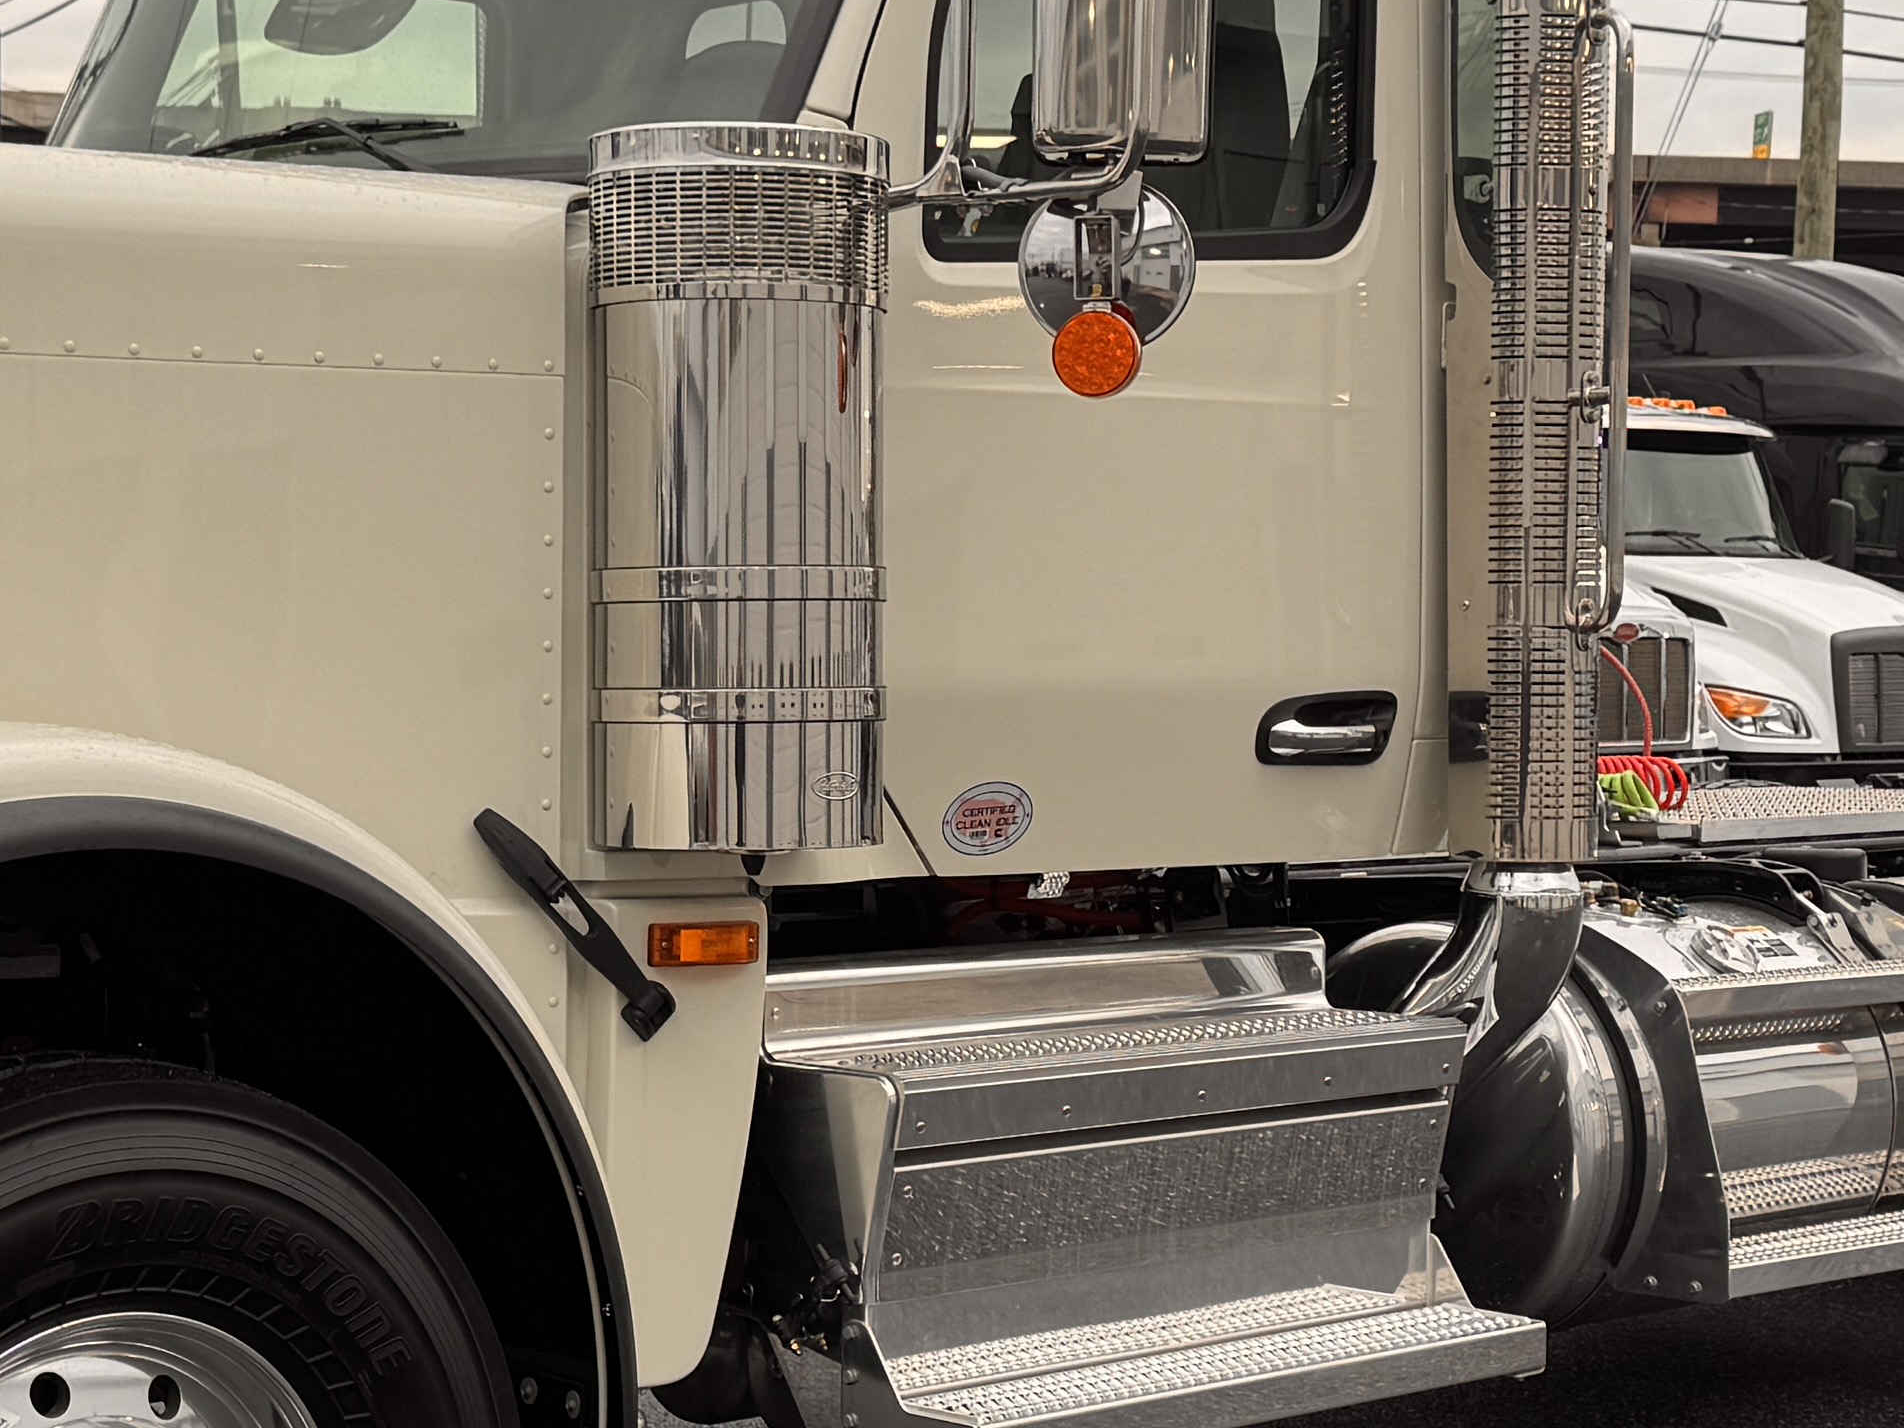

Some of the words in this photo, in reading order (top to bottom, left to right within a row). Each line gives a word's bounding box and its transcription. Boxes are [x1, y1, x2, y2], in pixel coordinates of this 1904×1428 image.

[962, 804, 1016, 818] CERTIFIED
[956, 819, 991, 830] CLEAN
[46, 1194, 414, 1378] BRIDGESTONE
